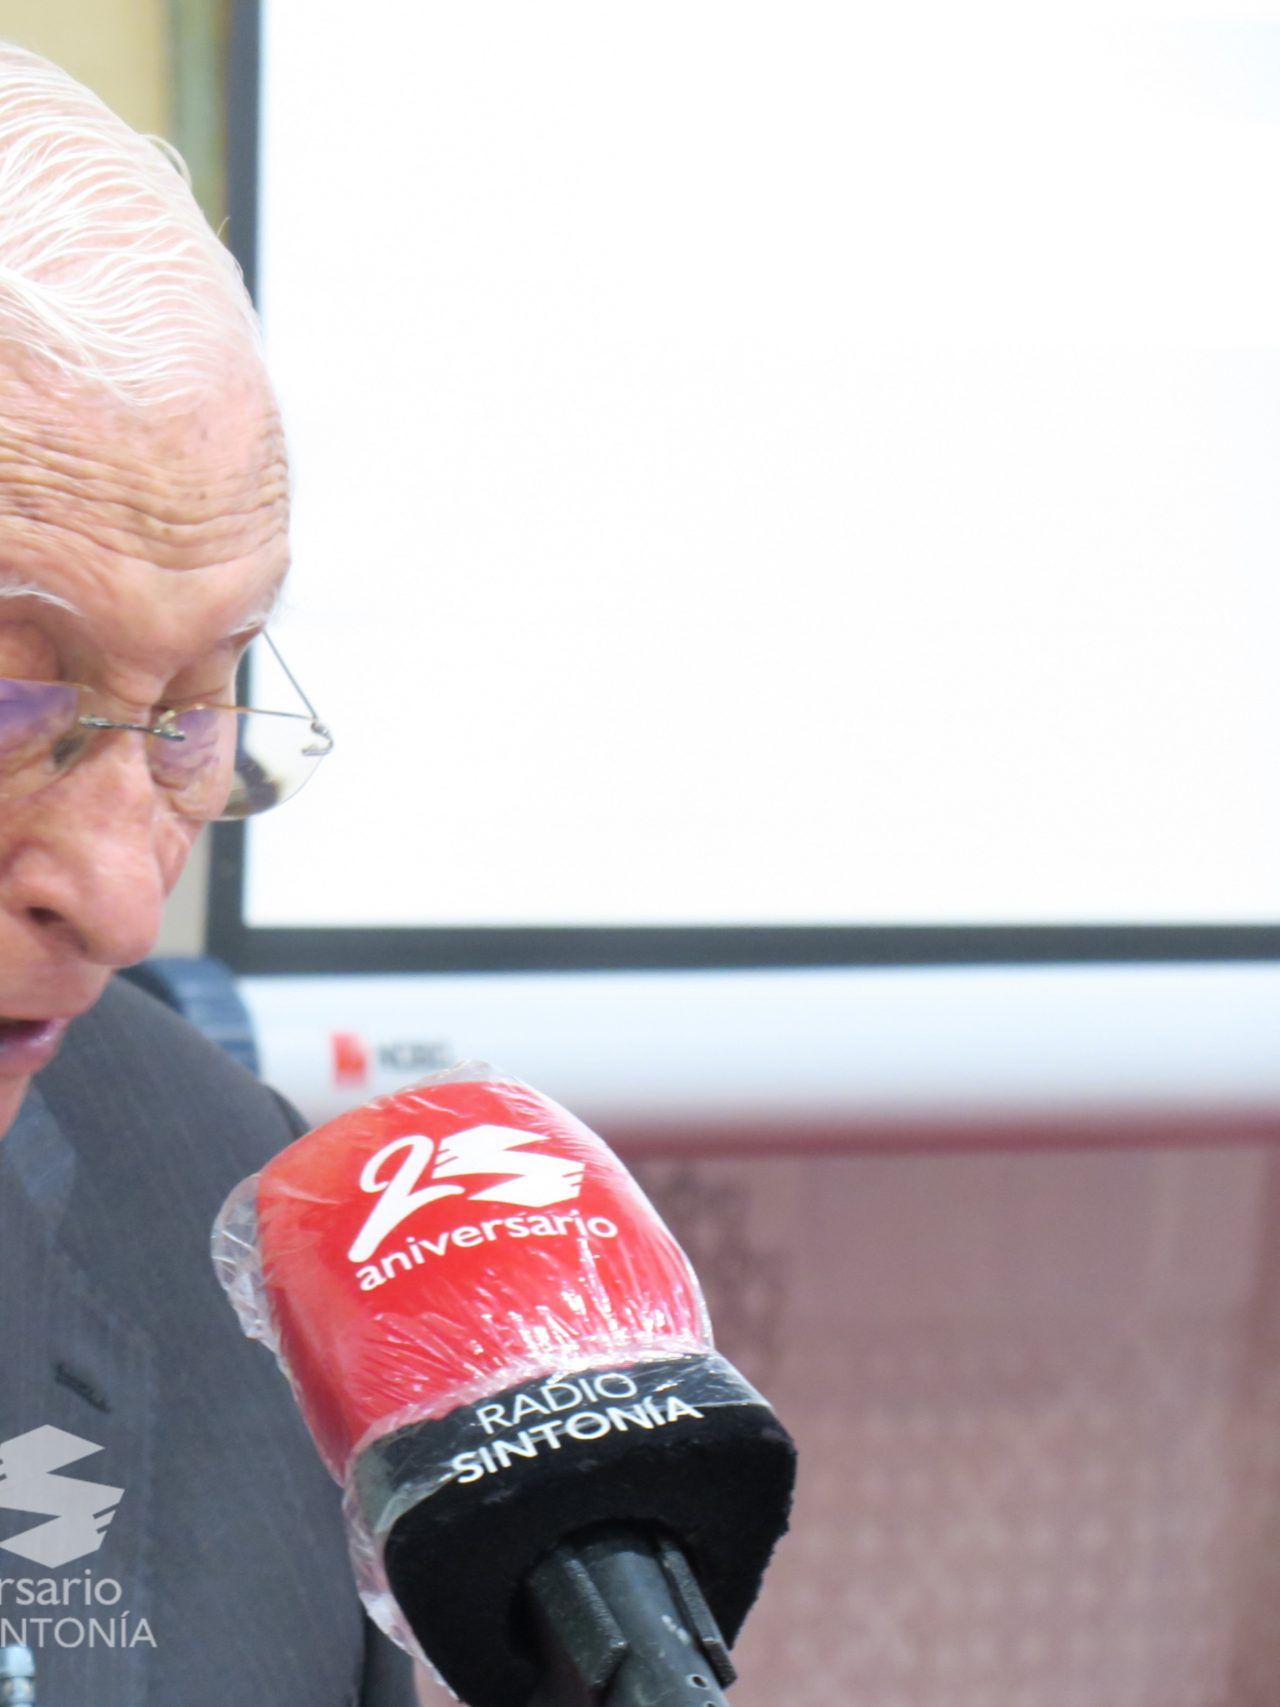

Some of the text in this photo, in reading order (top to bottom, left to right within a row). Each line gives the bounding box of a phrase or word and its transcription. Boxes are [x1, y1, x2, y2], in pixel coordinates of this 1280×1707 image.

[355, 1209, 618, 1291] aniversario
[450, 1395, 704, 1484] SINTONÍA
[475, 1373, 637, 1434] RADIO
